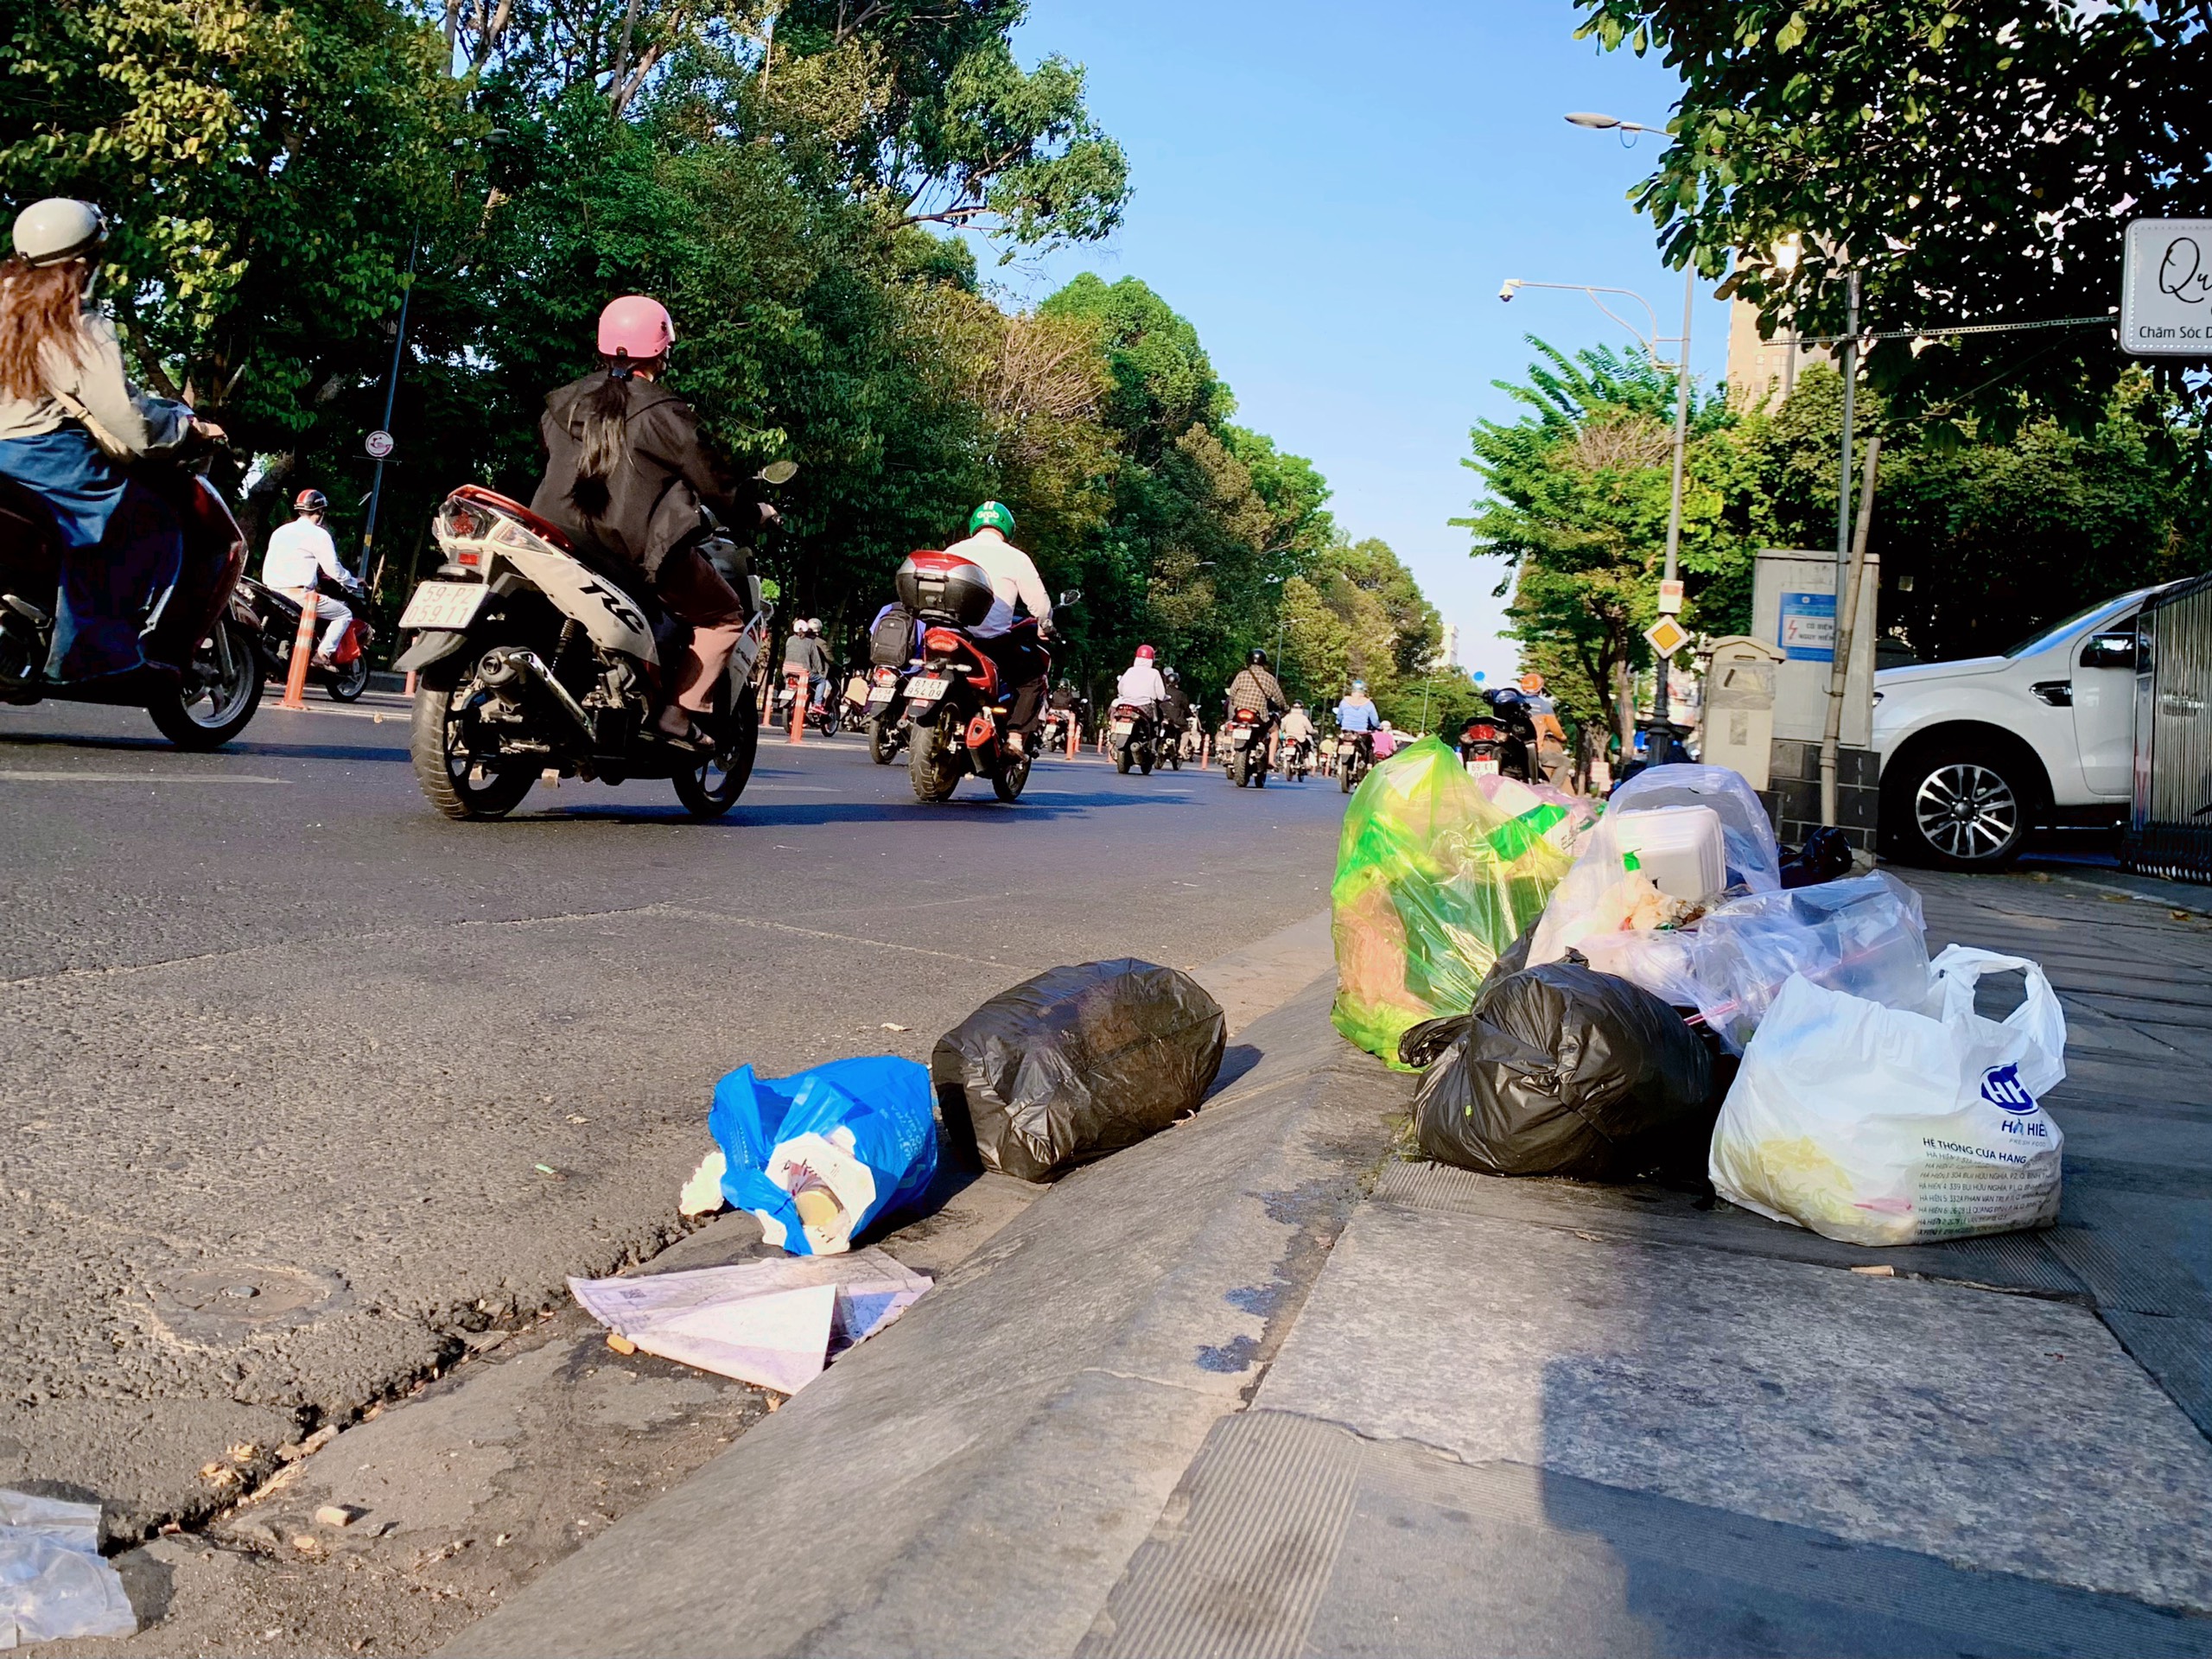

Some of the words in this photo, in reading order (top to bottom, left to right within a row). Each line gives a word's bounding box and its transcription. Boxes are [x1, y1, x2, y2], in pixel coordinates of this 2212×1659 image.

[2139, 325, 2176, 339] Chăm
[2179, 326, 2202, 339] Sóc
[976, 510, 1000, 519] Grab
[422, 586, 477, 604] 59-P2
[406, 605, 469, 623] 059.11
[914, 679, 942, 690] 61-E1
